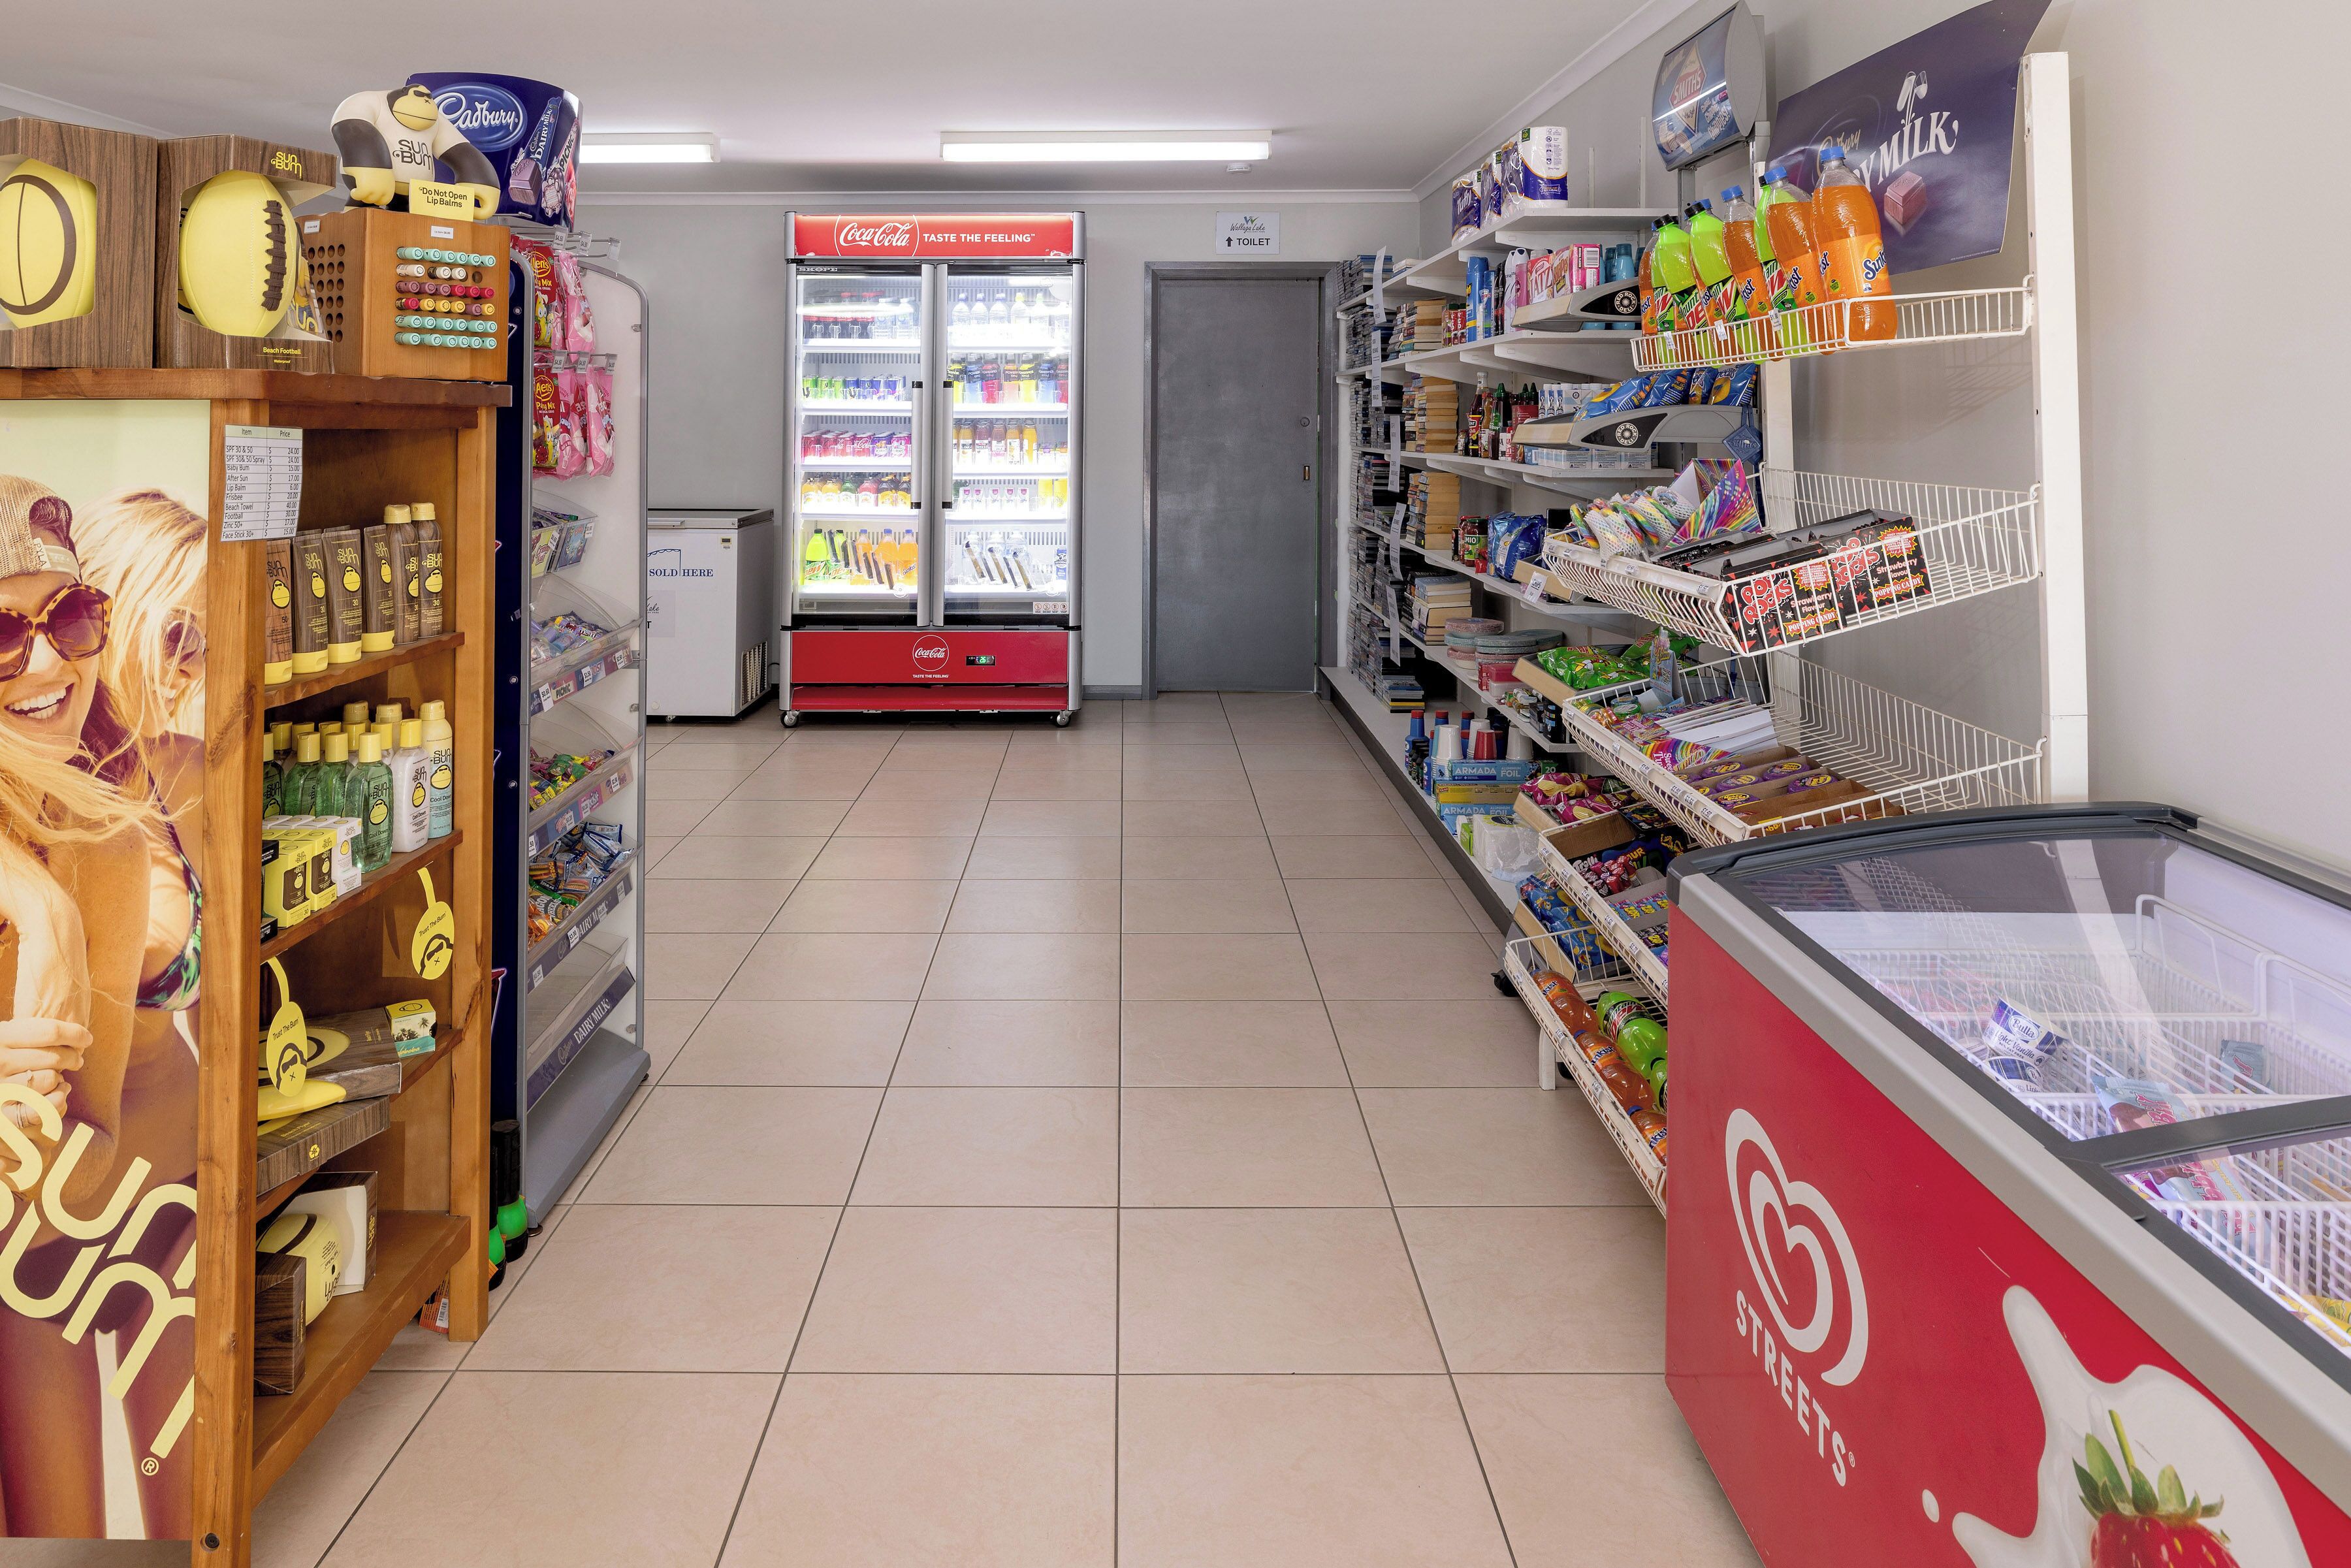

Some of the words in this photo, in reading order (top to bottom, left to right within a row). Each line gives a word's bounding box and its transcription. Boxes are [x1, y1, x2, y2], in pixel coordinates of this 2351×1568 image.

[558, 131, 575, 174] PICNIC
[1878, 111, 1959, 185] MILK
[421, 187, 433, 195] Do
[434, 189, 447, 198] Not
[448, 191, 468, 200] Open
[426, 196, 438, 206] Lip
[439, 198, 462, 208] Balms
[839, 221, 916, 248] Coca-Cola
[923, 232, 957, 243] TASTE
[959, 232, 982, 243] THE
[1230, 223, 1252, 234] Wallaga
[1624, 292, 1636, 304] ROCK
[1617, 425, 1625, 437] RED
[1625, 424, 1638, 436] ROCK
[648, 568, 679, 577] SOLD
[682, 568, 714, 577] HERE
[914, 647, 948, 658] Coca-Cola
[1443, 807, 1486, 815] ARMADA
[419, 925, 430, 937] Trust
[429, 920, 438, 931] The
[437, 913, 447, 925] Bum
[272, 1029, 283, 1041] Trust
[282, 1023, 291, 1033] The
[573, 1015, 594, 1044] DAIRY
[2011, 1016, 2037, 1040] Bulla
[2012, 1039, 2036, 1059] Vanilla
[1735, 1288, 1847, 1487] STREETS
